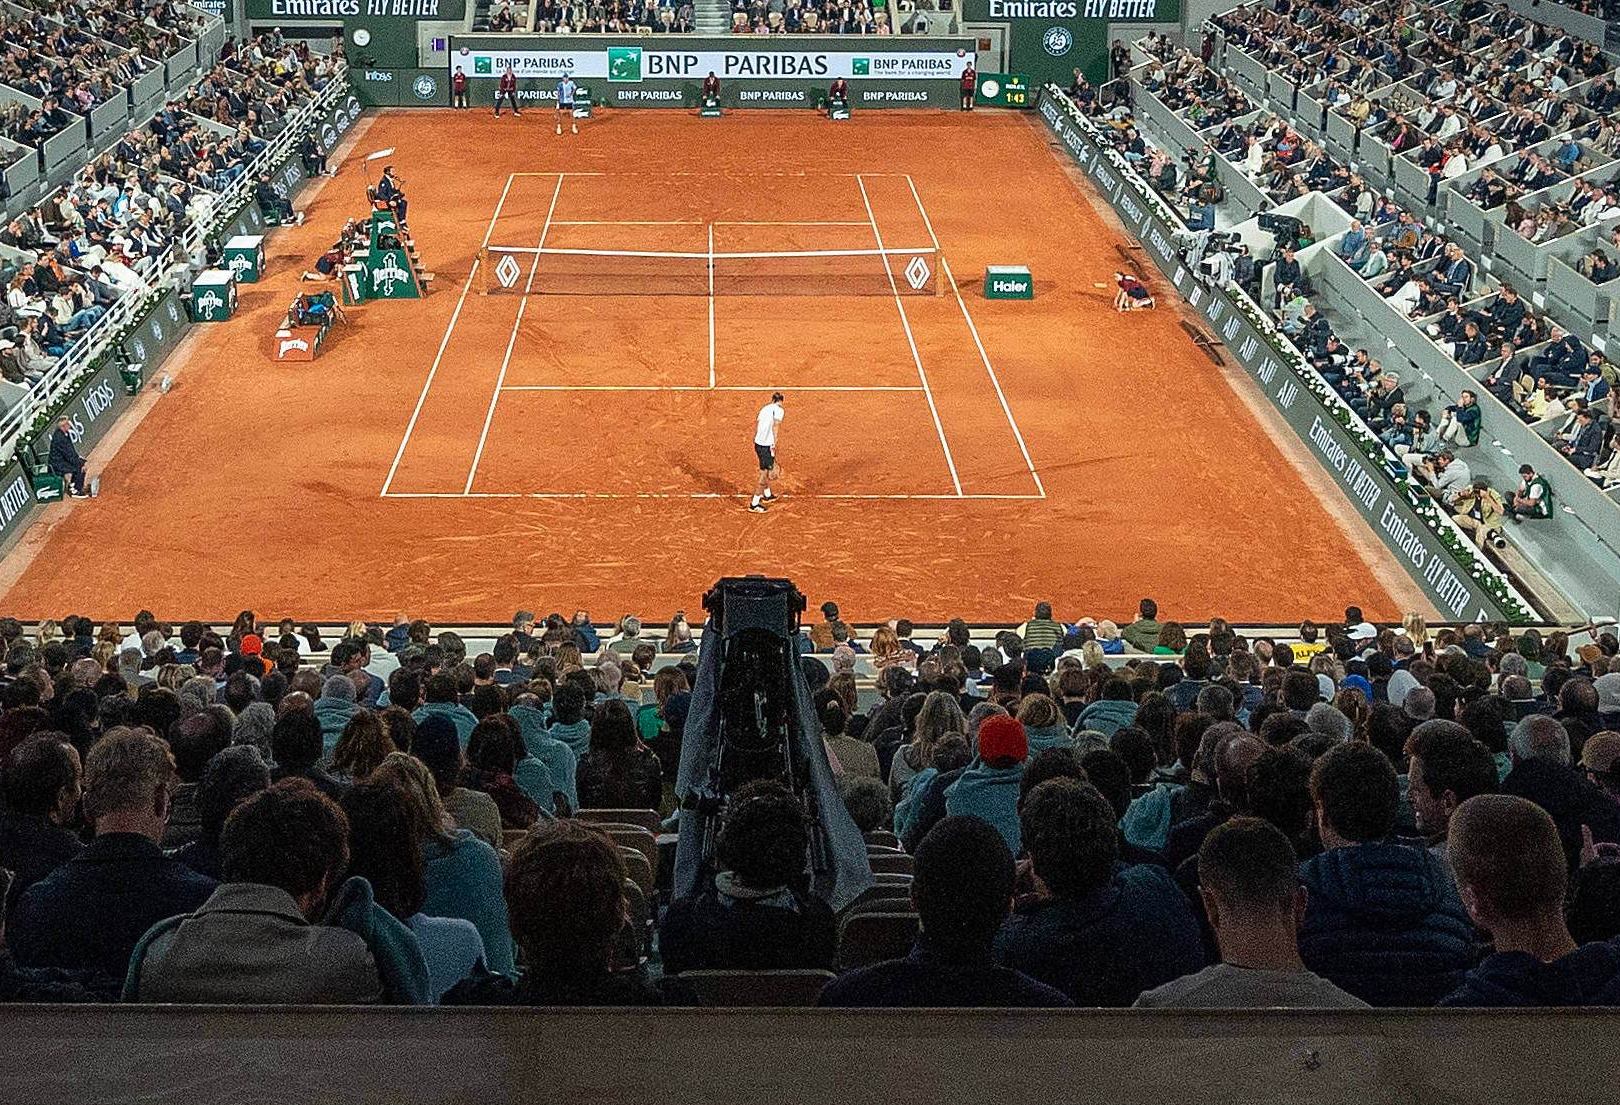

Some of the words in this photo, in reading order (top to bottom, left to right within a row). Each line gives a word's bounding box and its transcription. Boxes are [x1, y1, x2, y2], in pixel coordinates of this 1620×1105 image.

[1084, 0, 1107, 18] FLY
[1108, 0, 1156, 18] BETTER
[496, 57, 520, 68] BNP
[524, 57, 574, 68] PARIBAS
[648, 55, 699, 74] BNP
[725, 55, 828, 75] PARIBAS
[874, 59, 899, 69] BNP
[902, 59, 952, 69] PARIBAS
[517, 91, 559, 100] PARIBAS
[618, 90, 638, 100] BNP
[640, 90, 683, 100] PARIBAS
[740, 91, 761, 100] BNP
[763, 91, 804, 100] PARIBAS
[863, 91, 884, 100] BNP
[885, 91, 928, 101] PARIBAS
[1149, 228, 1175, 262] RENAULT
[993, 280, 1028, 293] Haier
[82, 378, 115, 422] Infosys
[1309, 415, 1346, 472] Emirates
[1343, 458, 1361, 485] FLY
[1354, 469, 1382, 512] BETTER
[1, 476, 30, 521] BETTER
[1380, 501, 1428, 568] Emirates
[1424, 554, 1445, 586] FLY
[1435, 567, 1471, 618] BETTER
